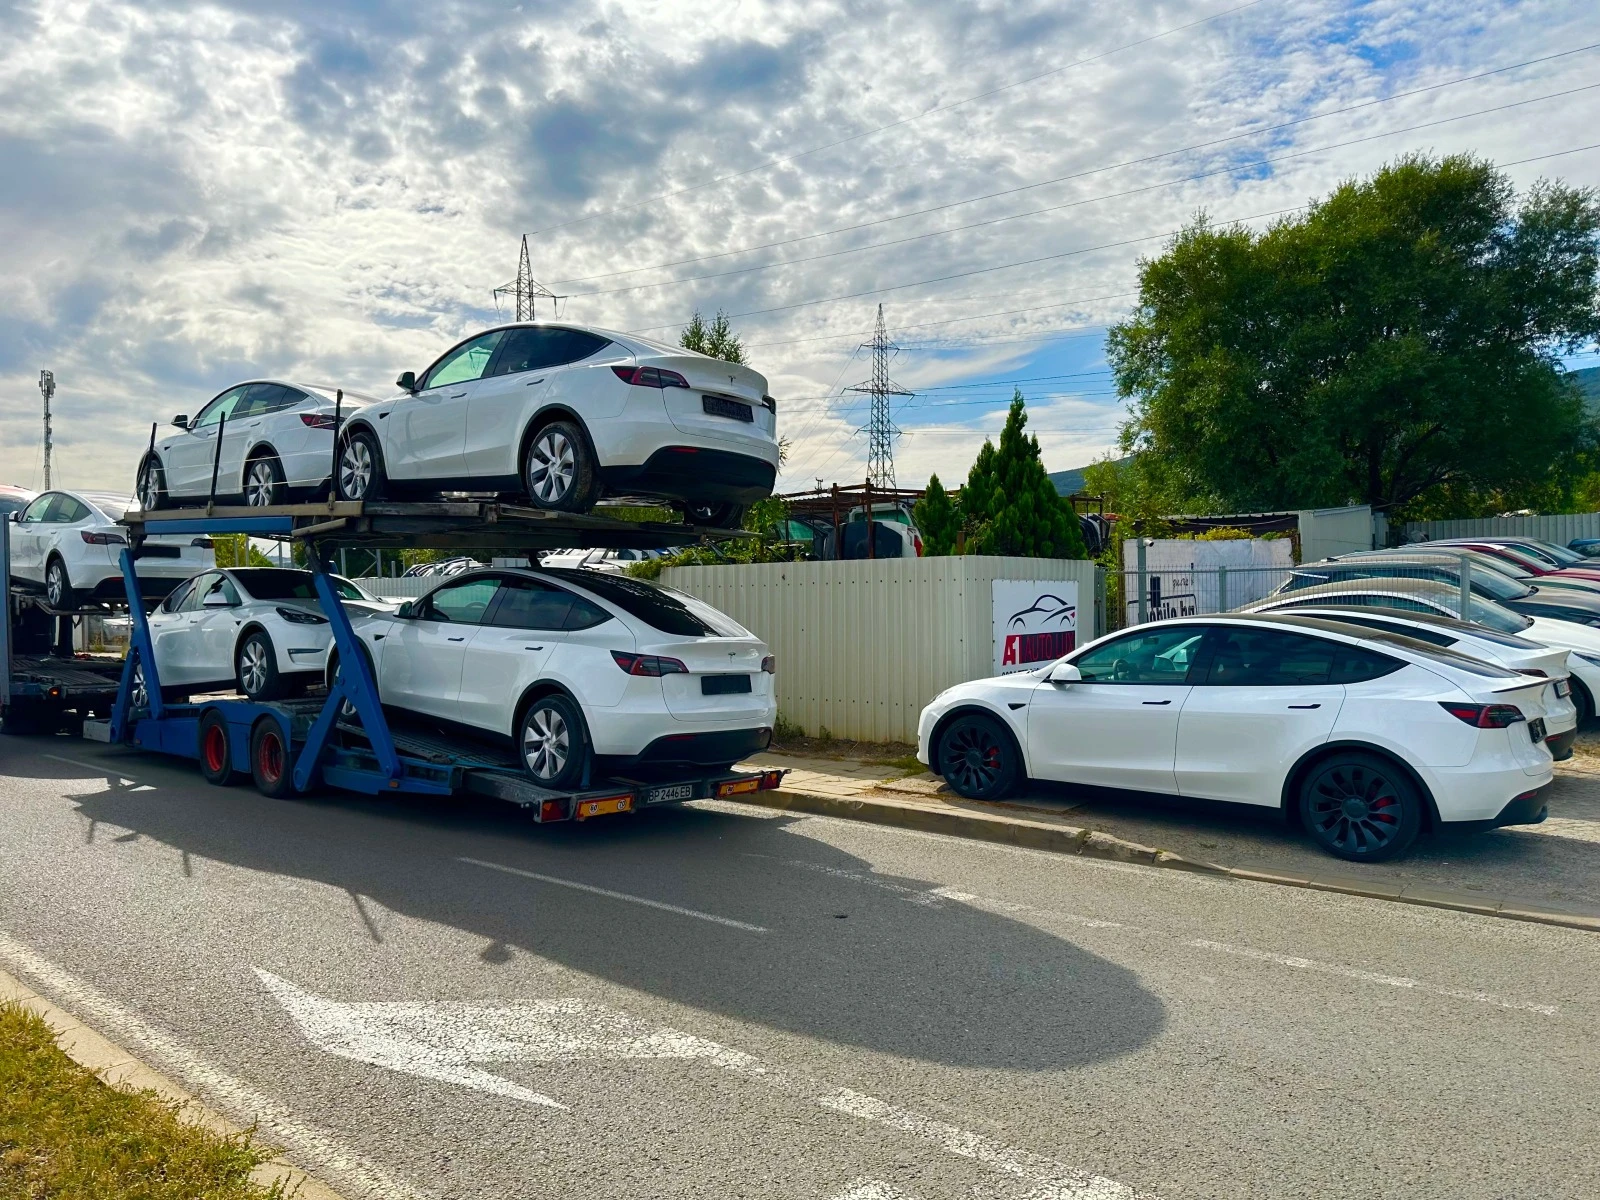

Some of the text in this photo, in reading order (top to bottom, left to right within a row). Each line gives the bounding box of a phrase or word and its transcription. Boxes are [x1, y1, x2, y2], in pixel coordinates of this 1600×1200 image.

[1139, 601, 1196, 623] obilebg
[1002, 631, 1075, 666] A1 AUTO LUX
[661, 788, 680, 801] 2446
[680, 786, 691, 798] EB
